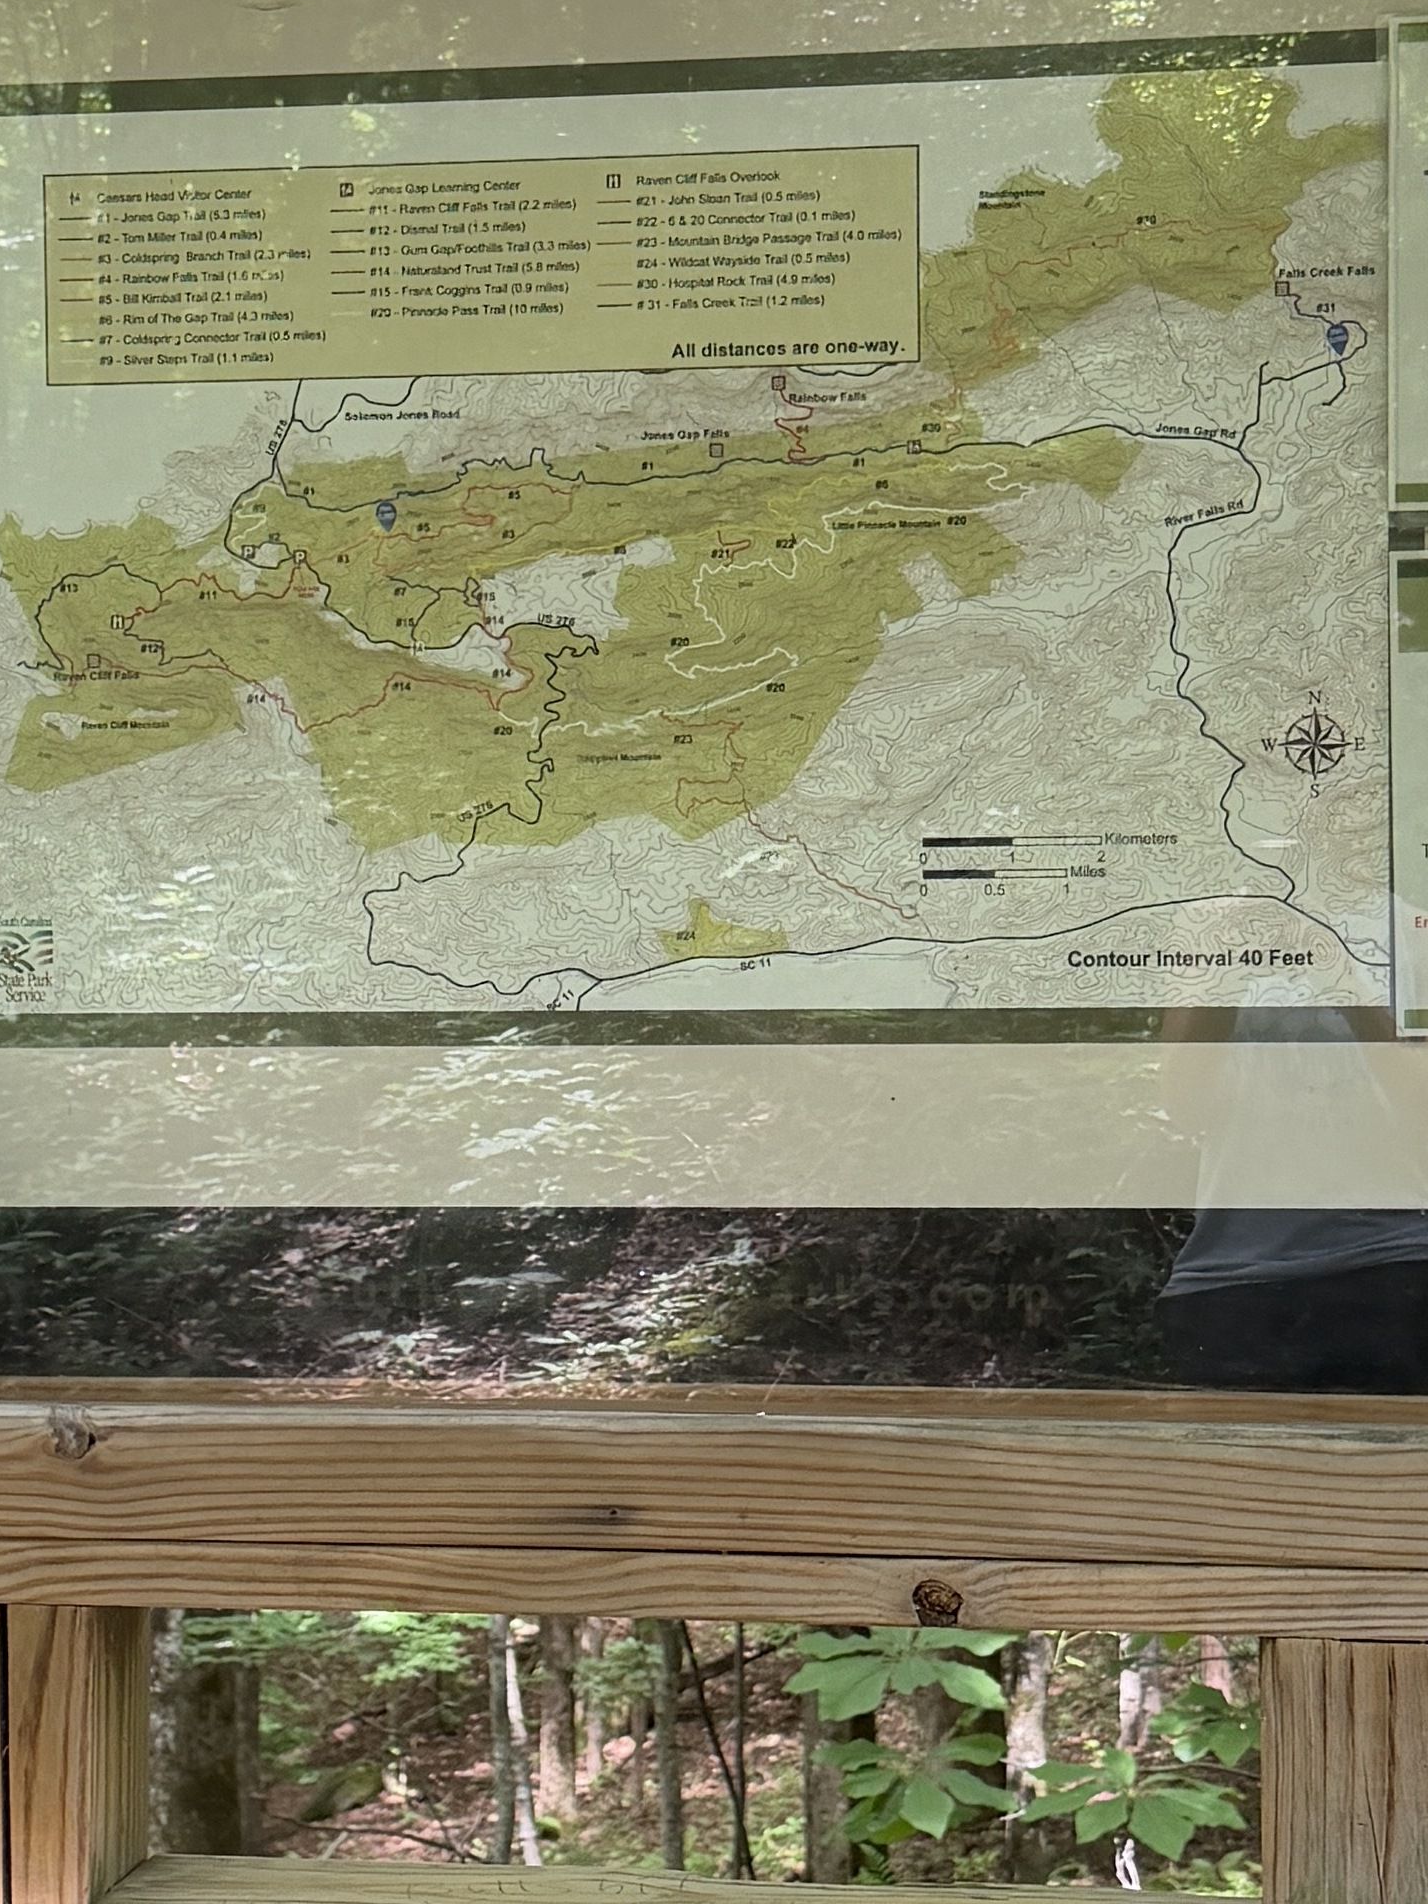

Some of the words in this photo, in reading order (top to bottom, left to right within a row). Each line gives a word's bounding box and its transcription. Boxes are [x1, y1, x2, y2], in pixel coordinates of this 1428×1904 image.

[672, 343, 695, 358] All
[702, 343, 786, 357] distances
[793, 344, 819, 356] are
[826, 341, 906, 355] one-way.
[1105, 832, 1177, 845] Kilometers
[1071, 866, 1106, 877] Miles
[1068, 951, 1150, 967] Contour
[1157, 950, 1231, 966] Interval
[1239, 951, 1262, 966] 40
[1270, 950, 1313, 965] Feet
